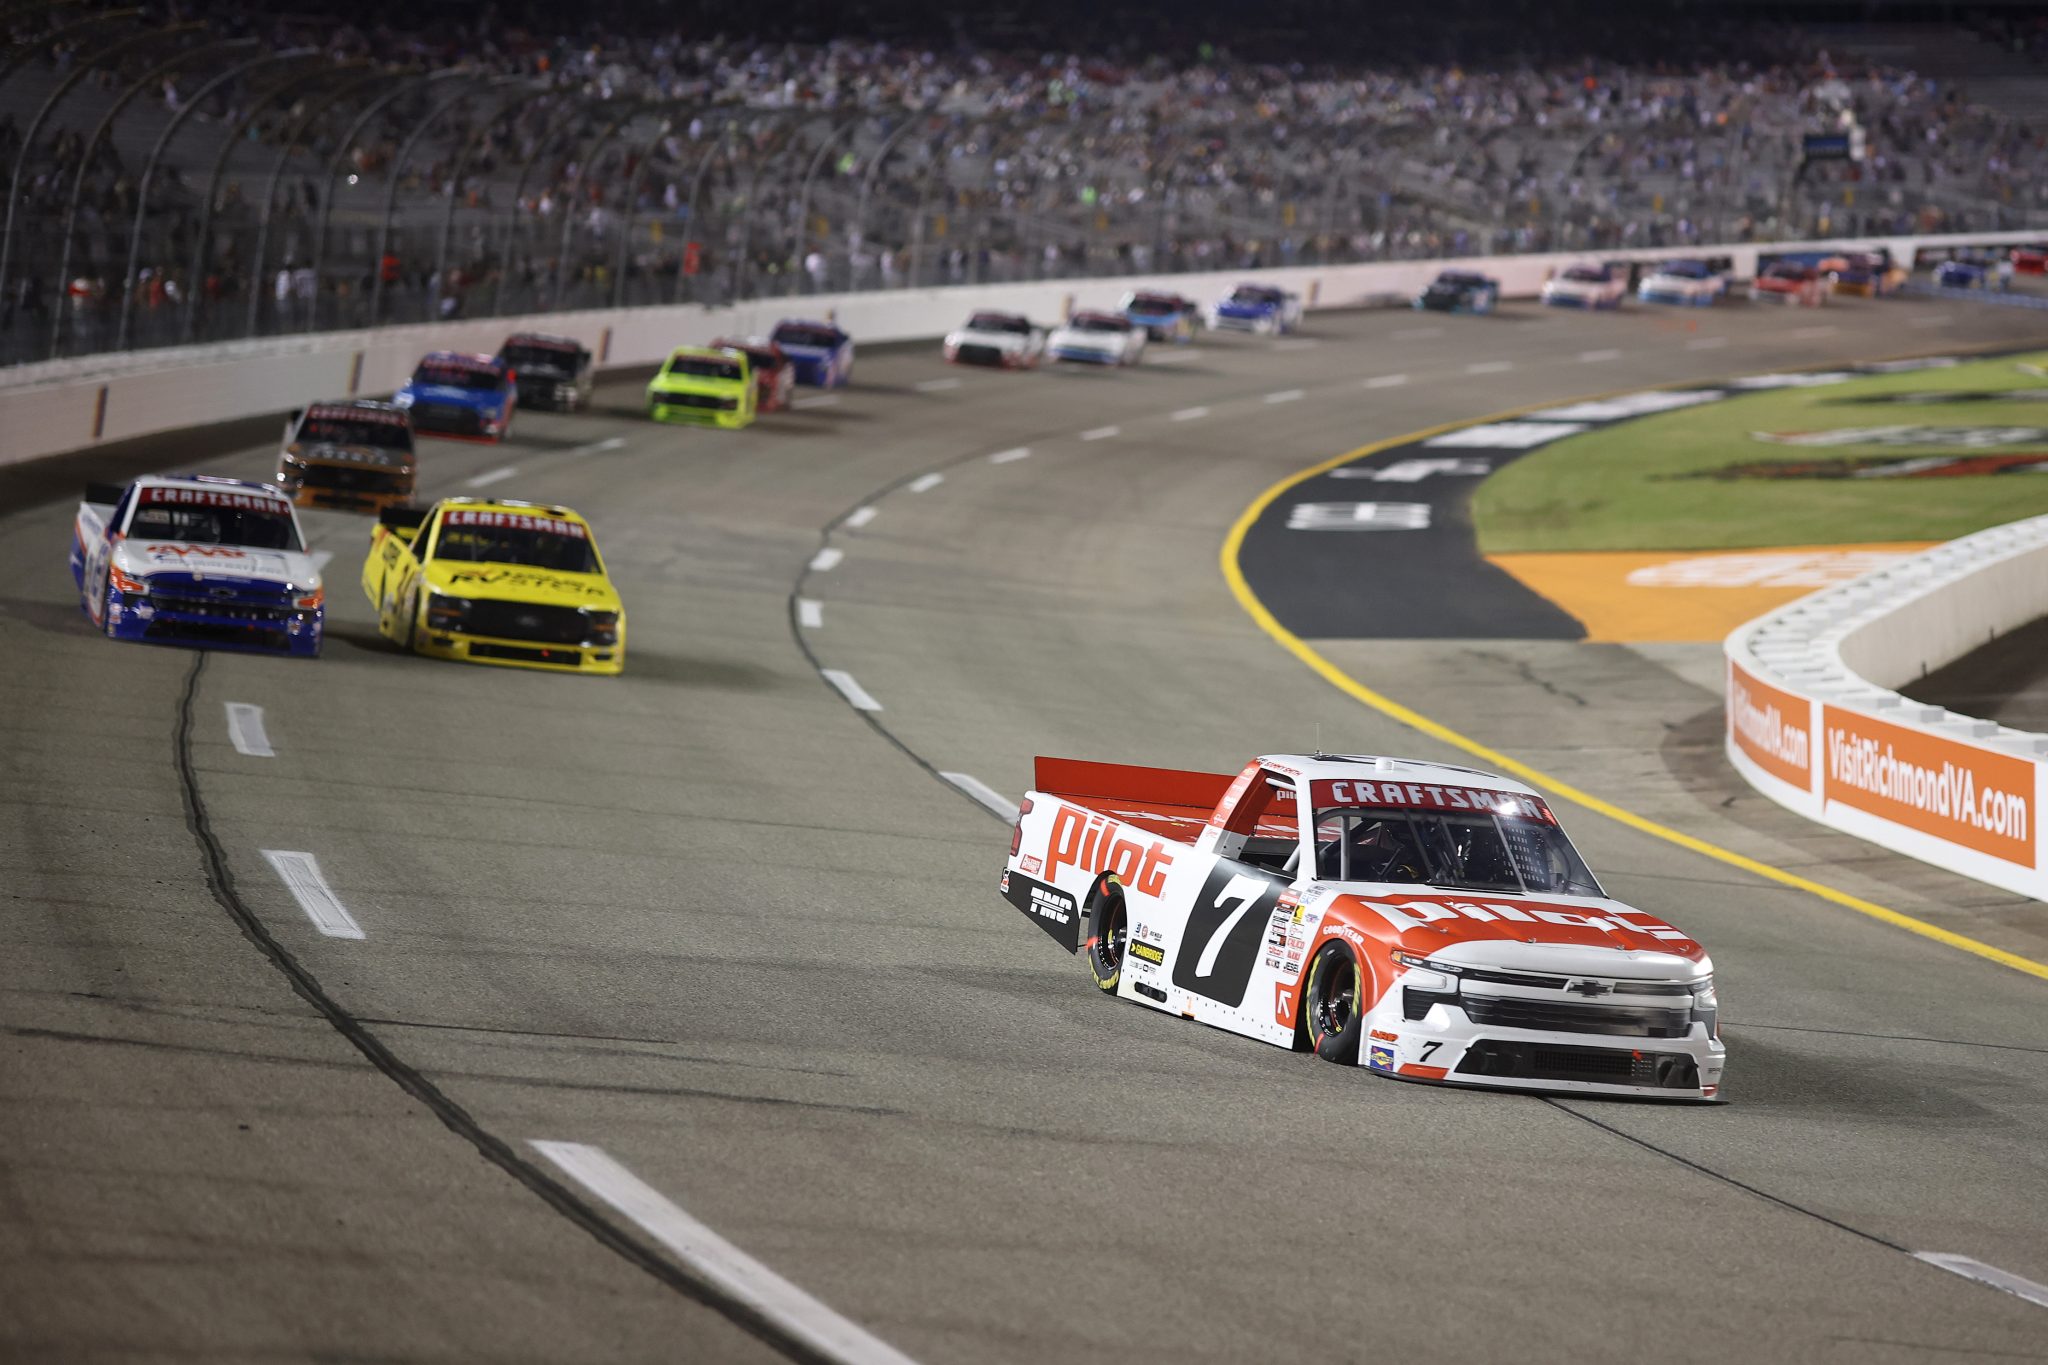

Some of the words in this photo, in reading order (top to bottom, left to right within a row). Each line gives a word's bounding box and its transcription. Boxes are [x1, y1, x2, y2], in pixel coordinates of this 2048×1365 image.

[151, 488, 281, 513] CRAFTSMAN
[449, 511, 586, 539] CRAFTSMAN
[1828, 728, 2028, 841] VisitRichmondVA.com
[1044, 804, 1174, 899] pilot
[1030, 887, 1073, 925] TMC
[1359, 901, 1691, 939] pilot
[1195, 874, 1271, 978] 7
[1419, 1041, 1444, 1062] 7
